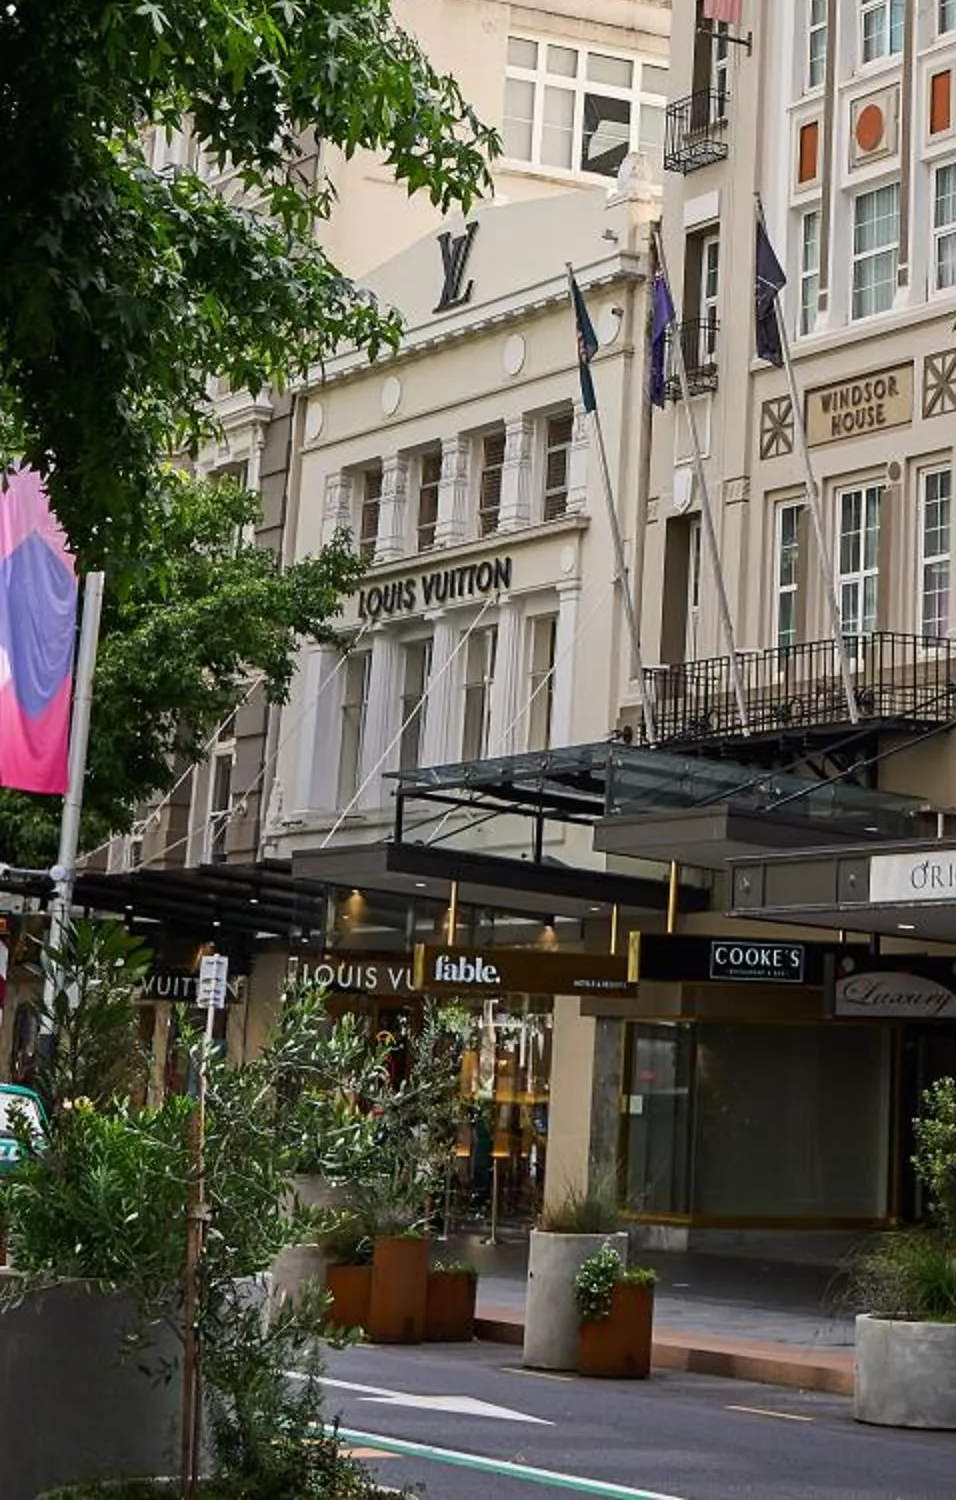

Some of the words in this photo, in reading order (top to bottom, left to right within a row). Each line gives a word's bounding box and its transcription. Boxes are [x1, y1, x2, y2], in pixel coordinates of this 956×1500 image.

[820, 376, 900, 414] WINDSOR
[831, 403, 887, 437] HOUSE
[358, 578, 417, 620] LOUIS
[421, 556, 512, 606] VUITTON
[714, 946, 801, 969] COOKE'S
